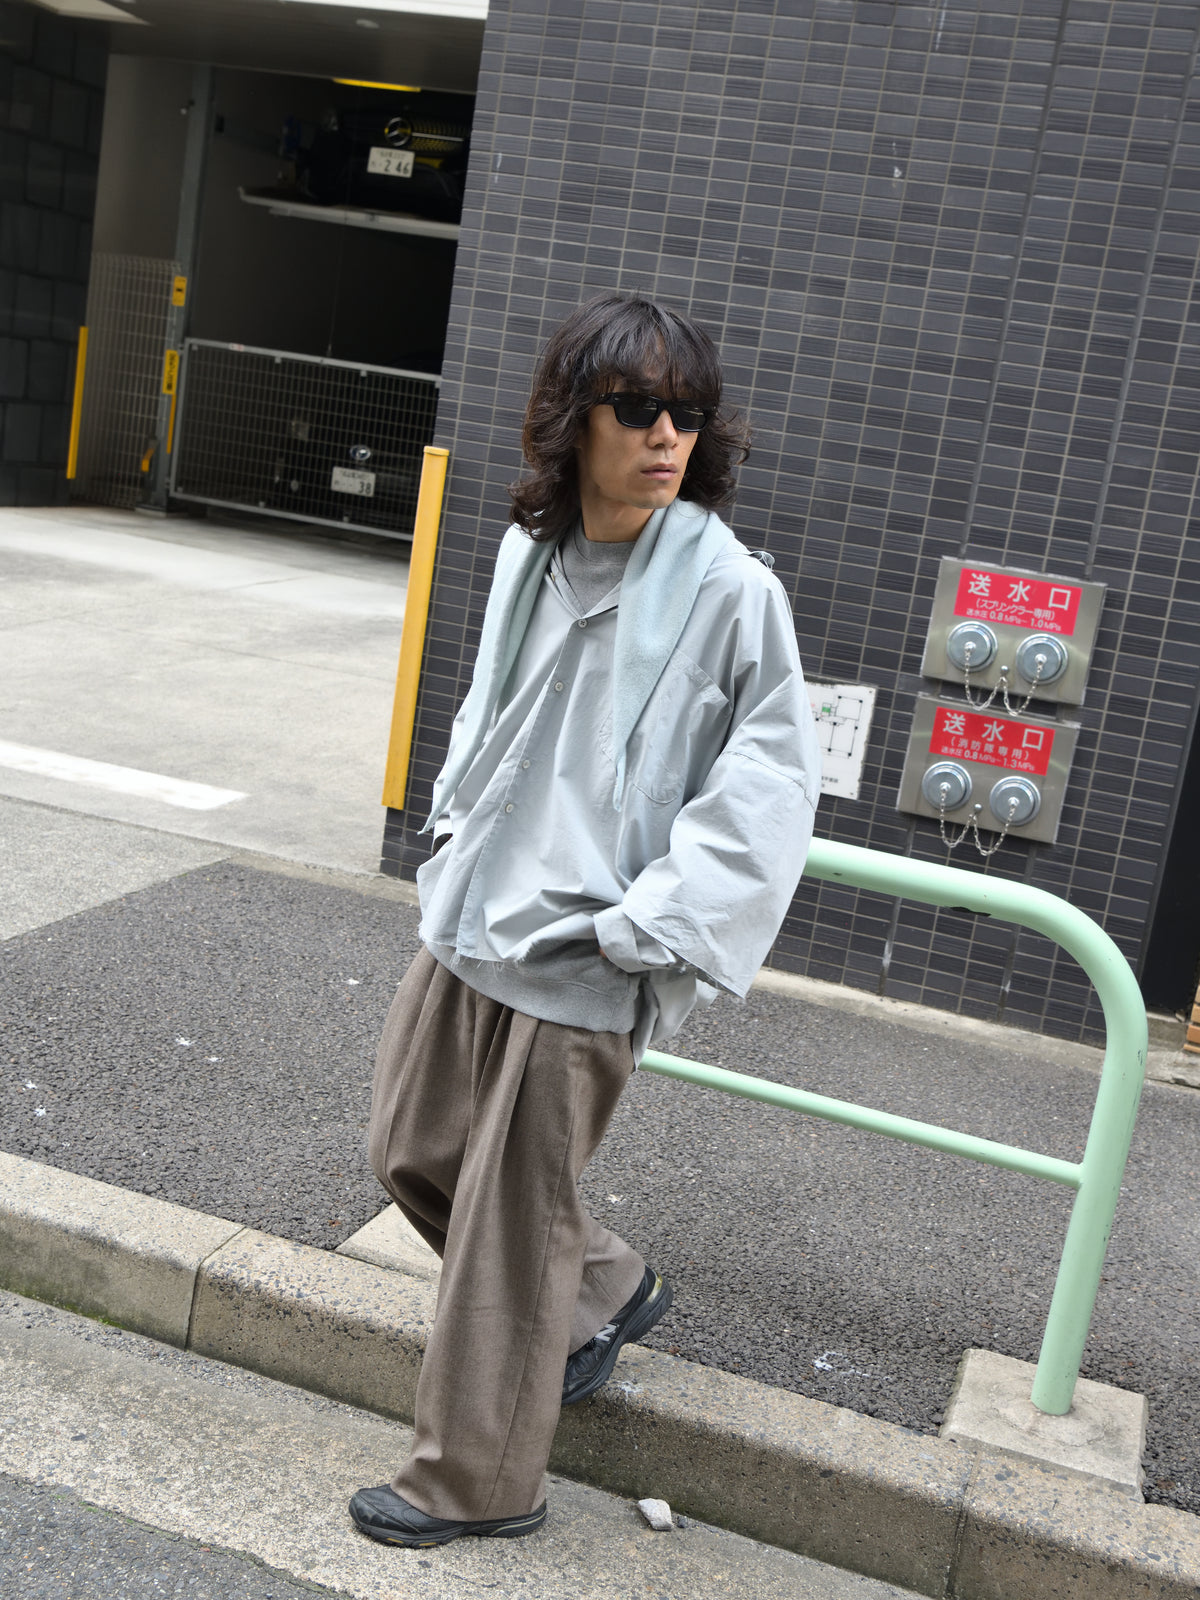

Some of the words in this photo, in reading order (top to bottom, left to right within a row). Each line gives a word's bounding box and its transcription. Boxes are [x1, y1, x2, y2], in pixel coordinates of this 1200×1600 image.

[967, 573, 1071, 611] 送水口
[943, 712, 1044, 751] 送水口
